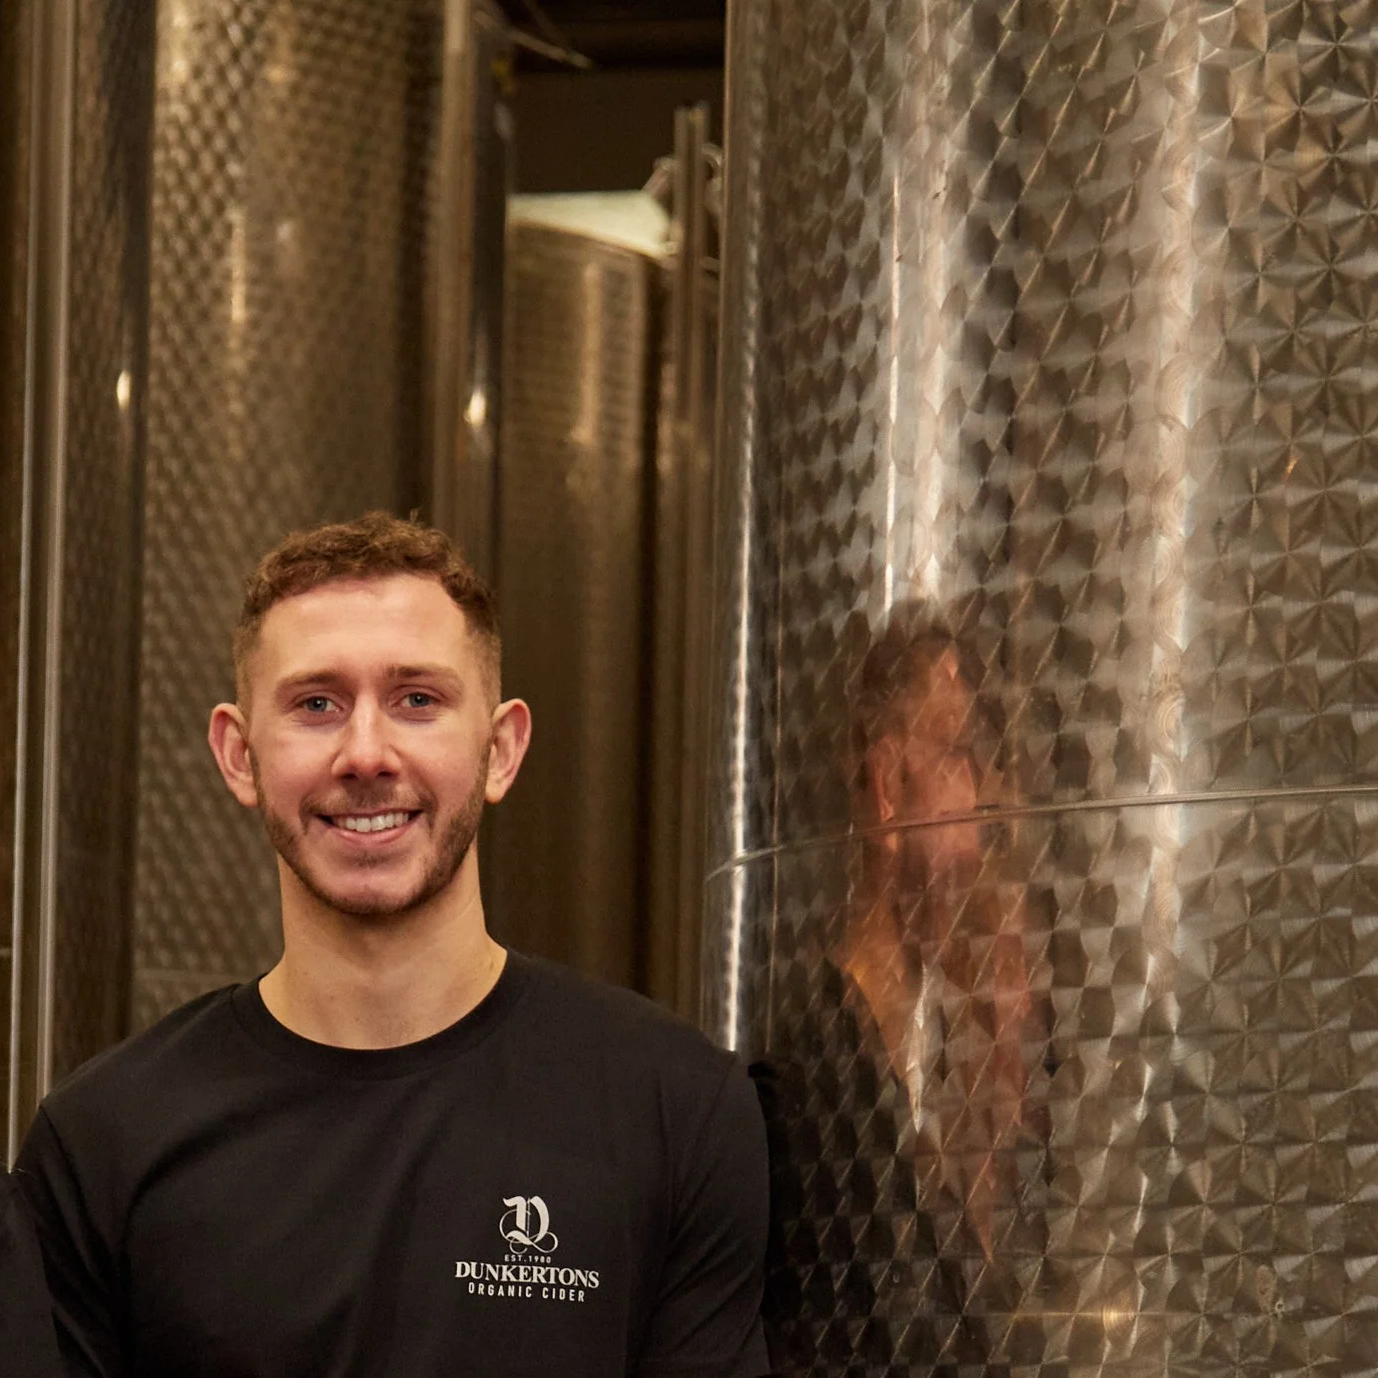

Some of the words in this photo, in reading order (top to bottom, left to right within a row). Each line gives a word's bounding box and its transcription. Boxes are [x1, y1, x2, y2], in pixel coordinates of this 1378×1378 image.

[455, 1261, 600, 1288] DUNKERTONS
[468, 1282, 532, 1298] ORGANIC
[542, 1287, 585, 1302] CIDER
